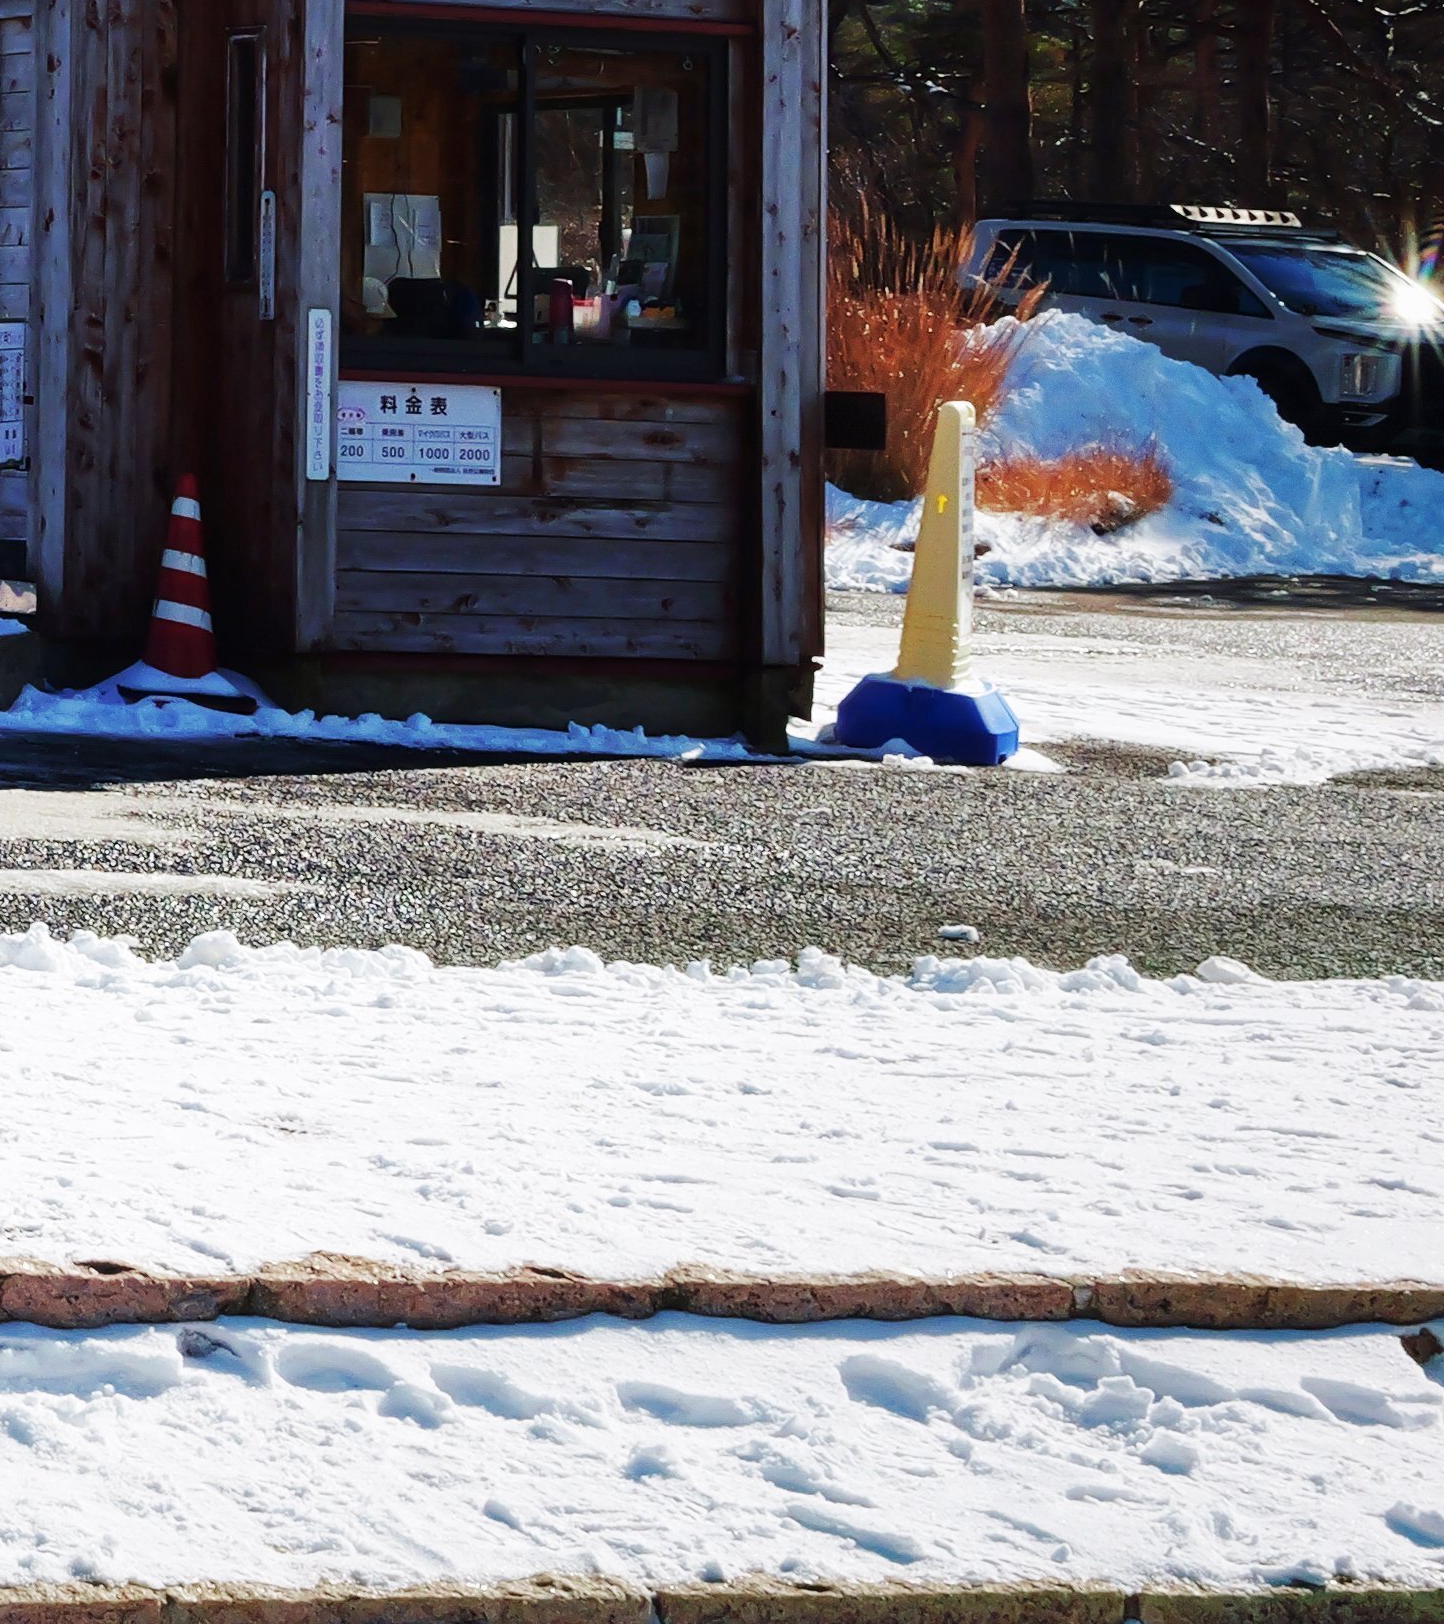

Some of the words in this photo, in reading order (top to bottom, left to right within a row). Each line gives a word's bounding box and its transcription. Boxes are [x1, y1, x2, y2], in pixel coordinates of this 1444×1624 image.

[380, 395, 448, 416] 料金表
[340, 445, 364, 457] 200
[381, 446, 405, 459] 500
[419, 447, 450, 460] 1000
[459, 448, 490, 461] 2000
